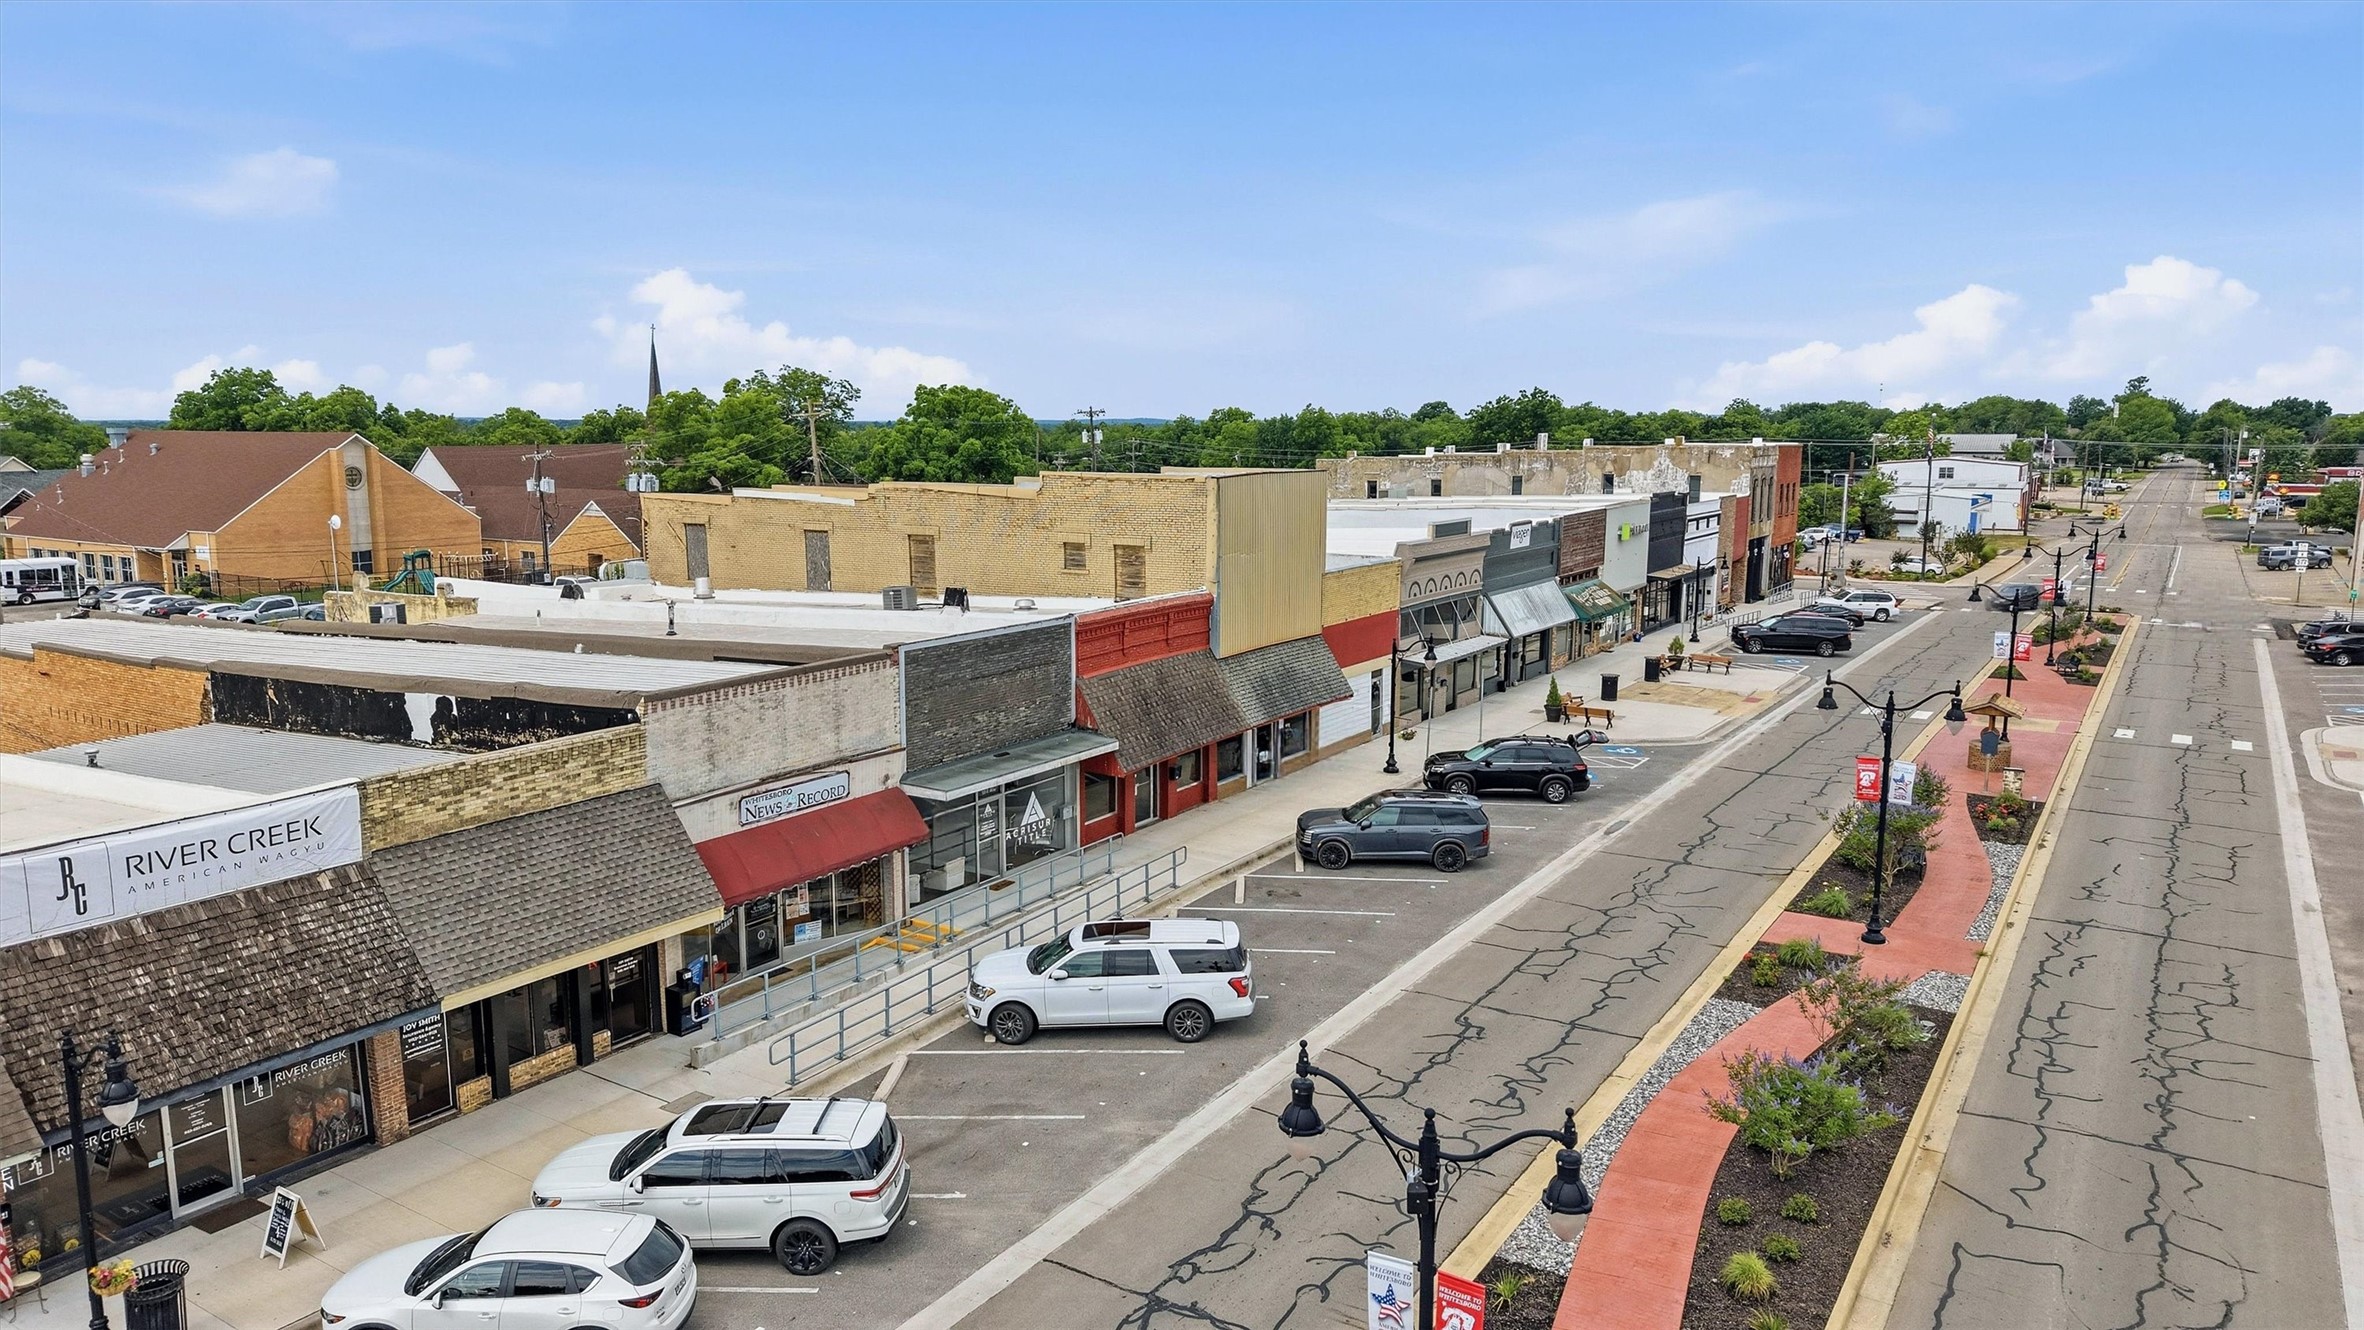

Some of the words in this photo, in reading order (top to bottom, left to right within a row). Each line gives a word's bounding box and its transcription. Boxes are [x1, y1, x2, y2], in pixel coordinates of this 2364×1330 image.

[744, 788, 793, 806] WHITESBORO
[745, 802, 783, 821] NEWS
[797, 785, 846, 808] RECORD
[1006, 816, 1054, 840] ACRISUR
[1018, 828, 1047, 845] TITLE
[126, 838, 218, 878] RIVER
[228, 816, 323, 854] CREEK
[128, 861, 243, 894] AMERICAN
[259, 841, 325, 864] WAGYU
[418, 1014, 440, 1027] SMITH
[275, 1063, 308, 1082] RIVER
[310, 1050, 346, 1069] CREEK
[101, 1119, 145, 1142] CREEK
[1369, 1265, 1401, 1279] WELCOME
[1439, 1286, 1472, 1301] WELCOME
[1473, 1297, 1482, 1305] TO
